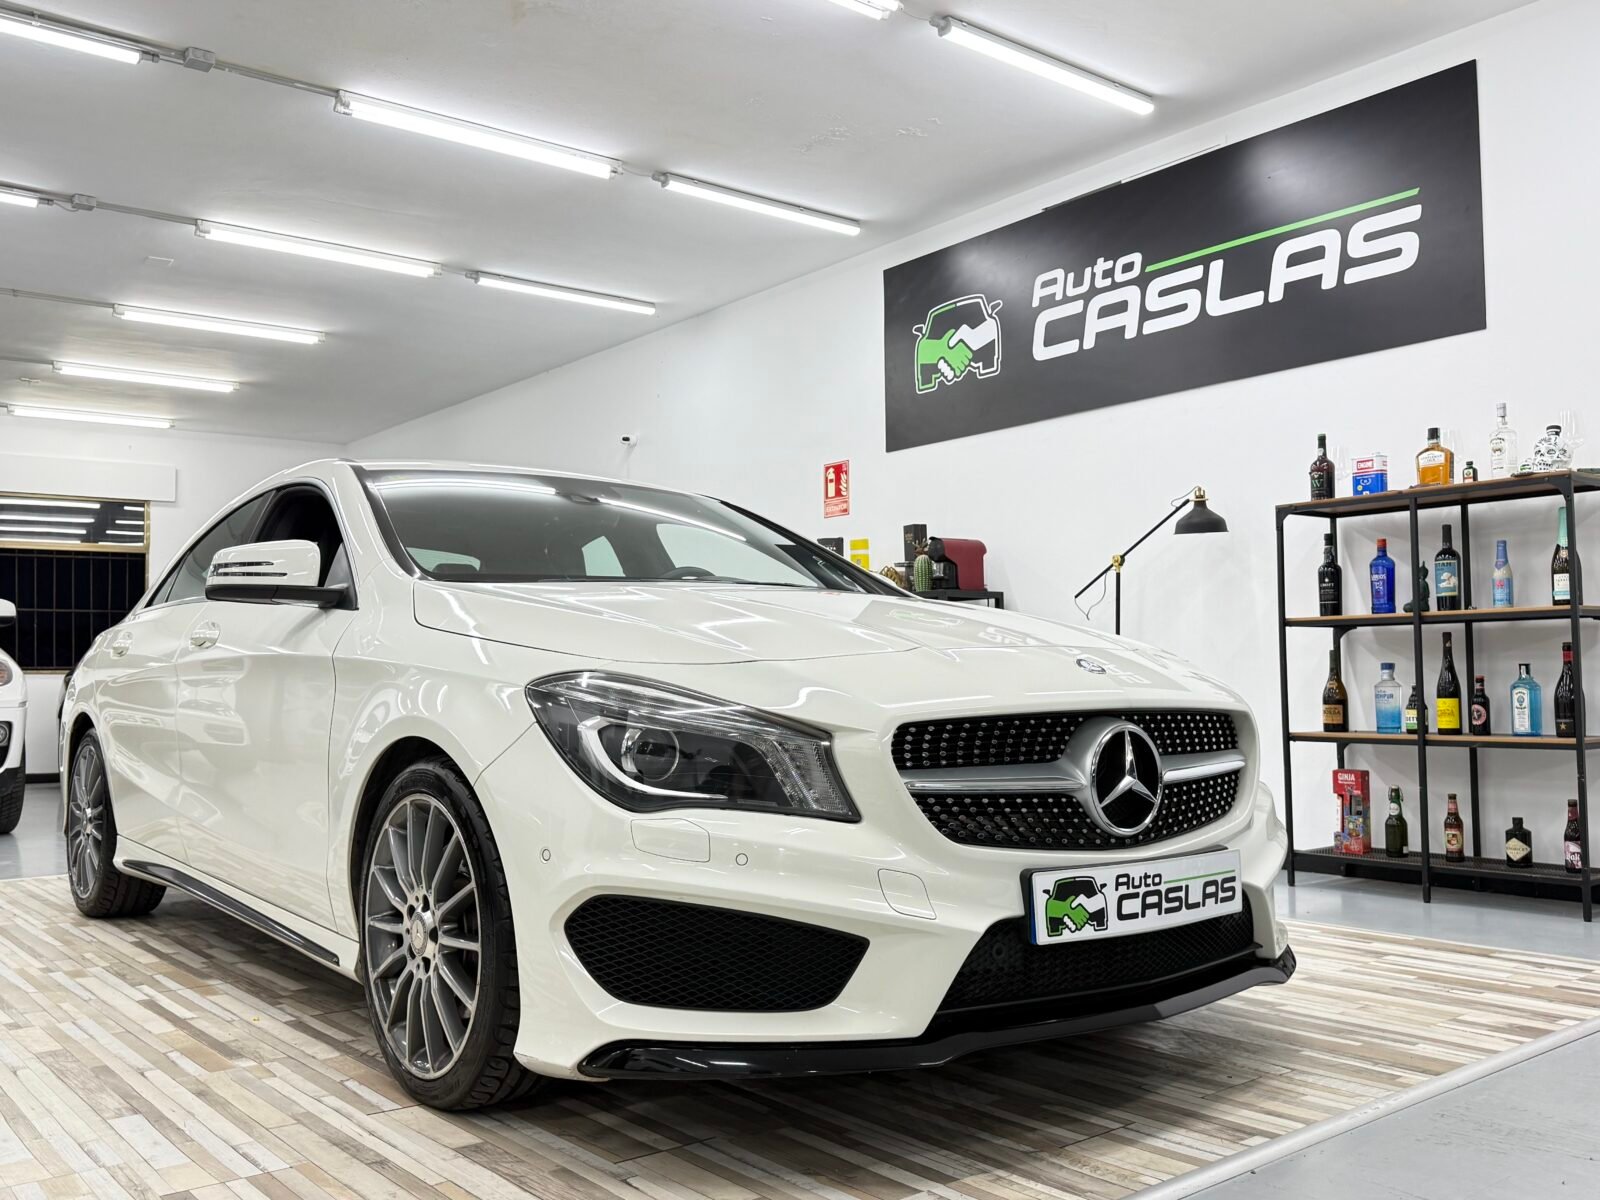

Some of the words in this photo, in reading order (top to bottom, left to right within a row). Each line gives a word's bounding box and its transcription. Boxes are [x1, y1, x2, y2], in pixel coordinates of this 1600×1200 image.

[1032, 252, 1143, 308] Auto
[1032, 204, 1422, 361] CASLAS
[1337, 772, 1356, 781] GINJA
[1115, 872, 1162, 891] Auto
[1116, 876, 1237, 921] CASLAS
